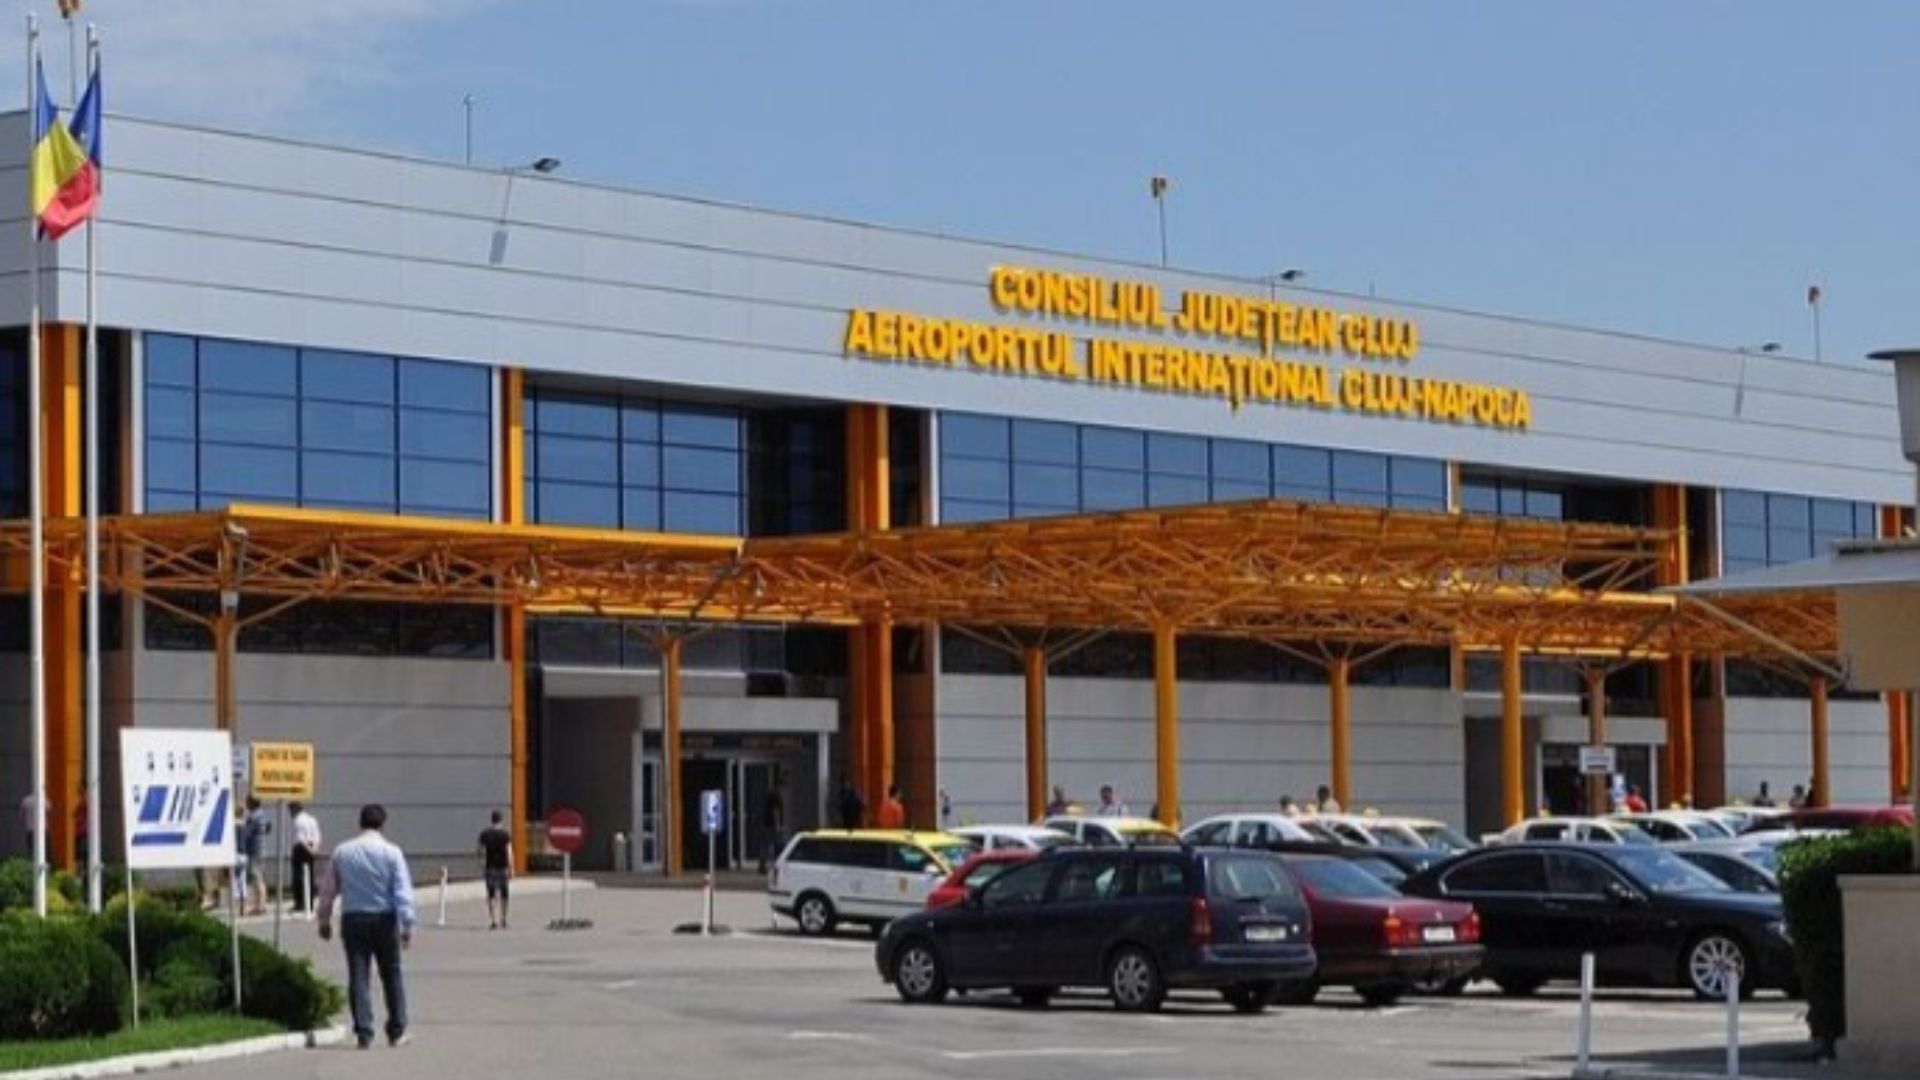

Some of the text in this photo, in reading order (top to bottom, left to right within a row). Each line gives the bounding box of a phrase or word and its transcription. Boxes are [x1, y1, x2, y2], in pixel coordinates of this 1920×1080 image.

[990, 265, 1167, 328] CONSILIUL
[1341, 316, 1419, 360] CLUJ
[845, 308, 1077, 378] AEROPORTUL
[1341, 369, 1532, 428] CLUJ-NAPOCA
